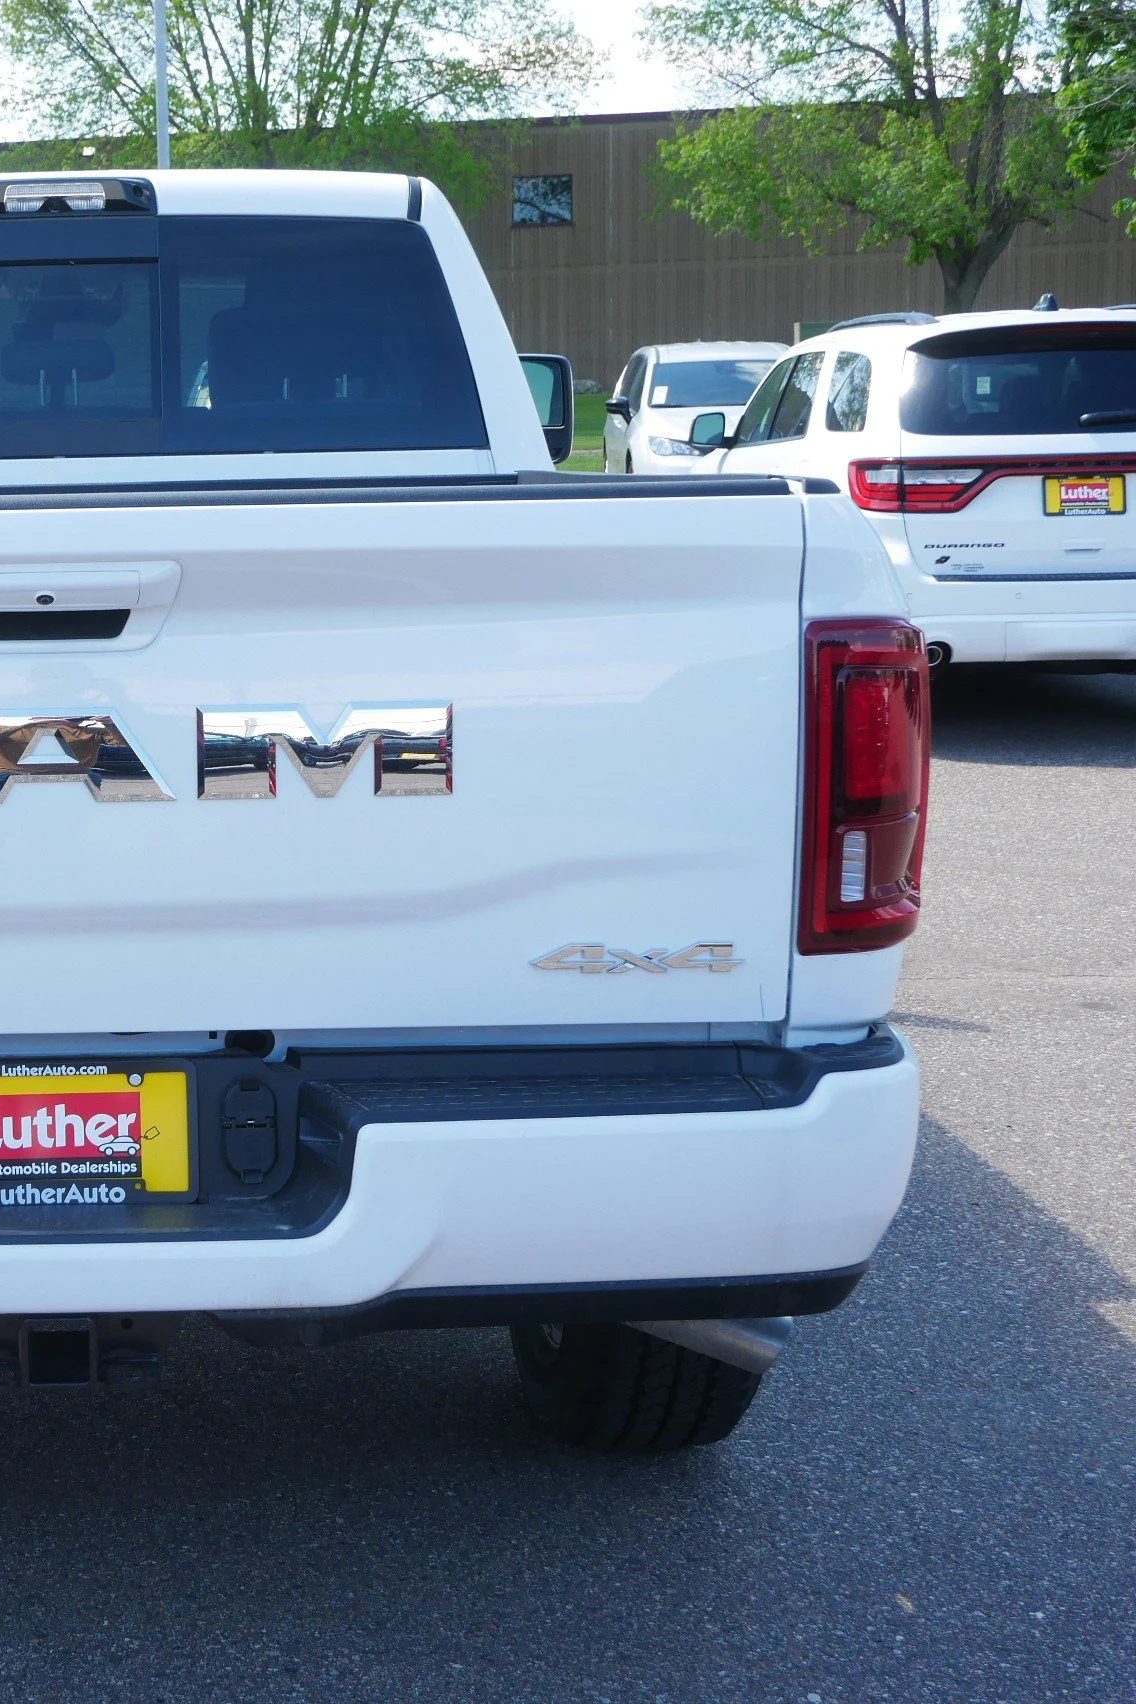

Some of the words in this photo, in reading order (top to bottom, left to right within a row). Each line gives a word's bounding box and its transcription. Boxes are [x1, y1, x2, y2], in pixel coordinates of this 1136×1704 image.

[1061, 485, 1109, 499] Luther
[1, 1064, 108, 1077] LutherAuto.com
[61, 1160, 138, 1176] Dealerships
